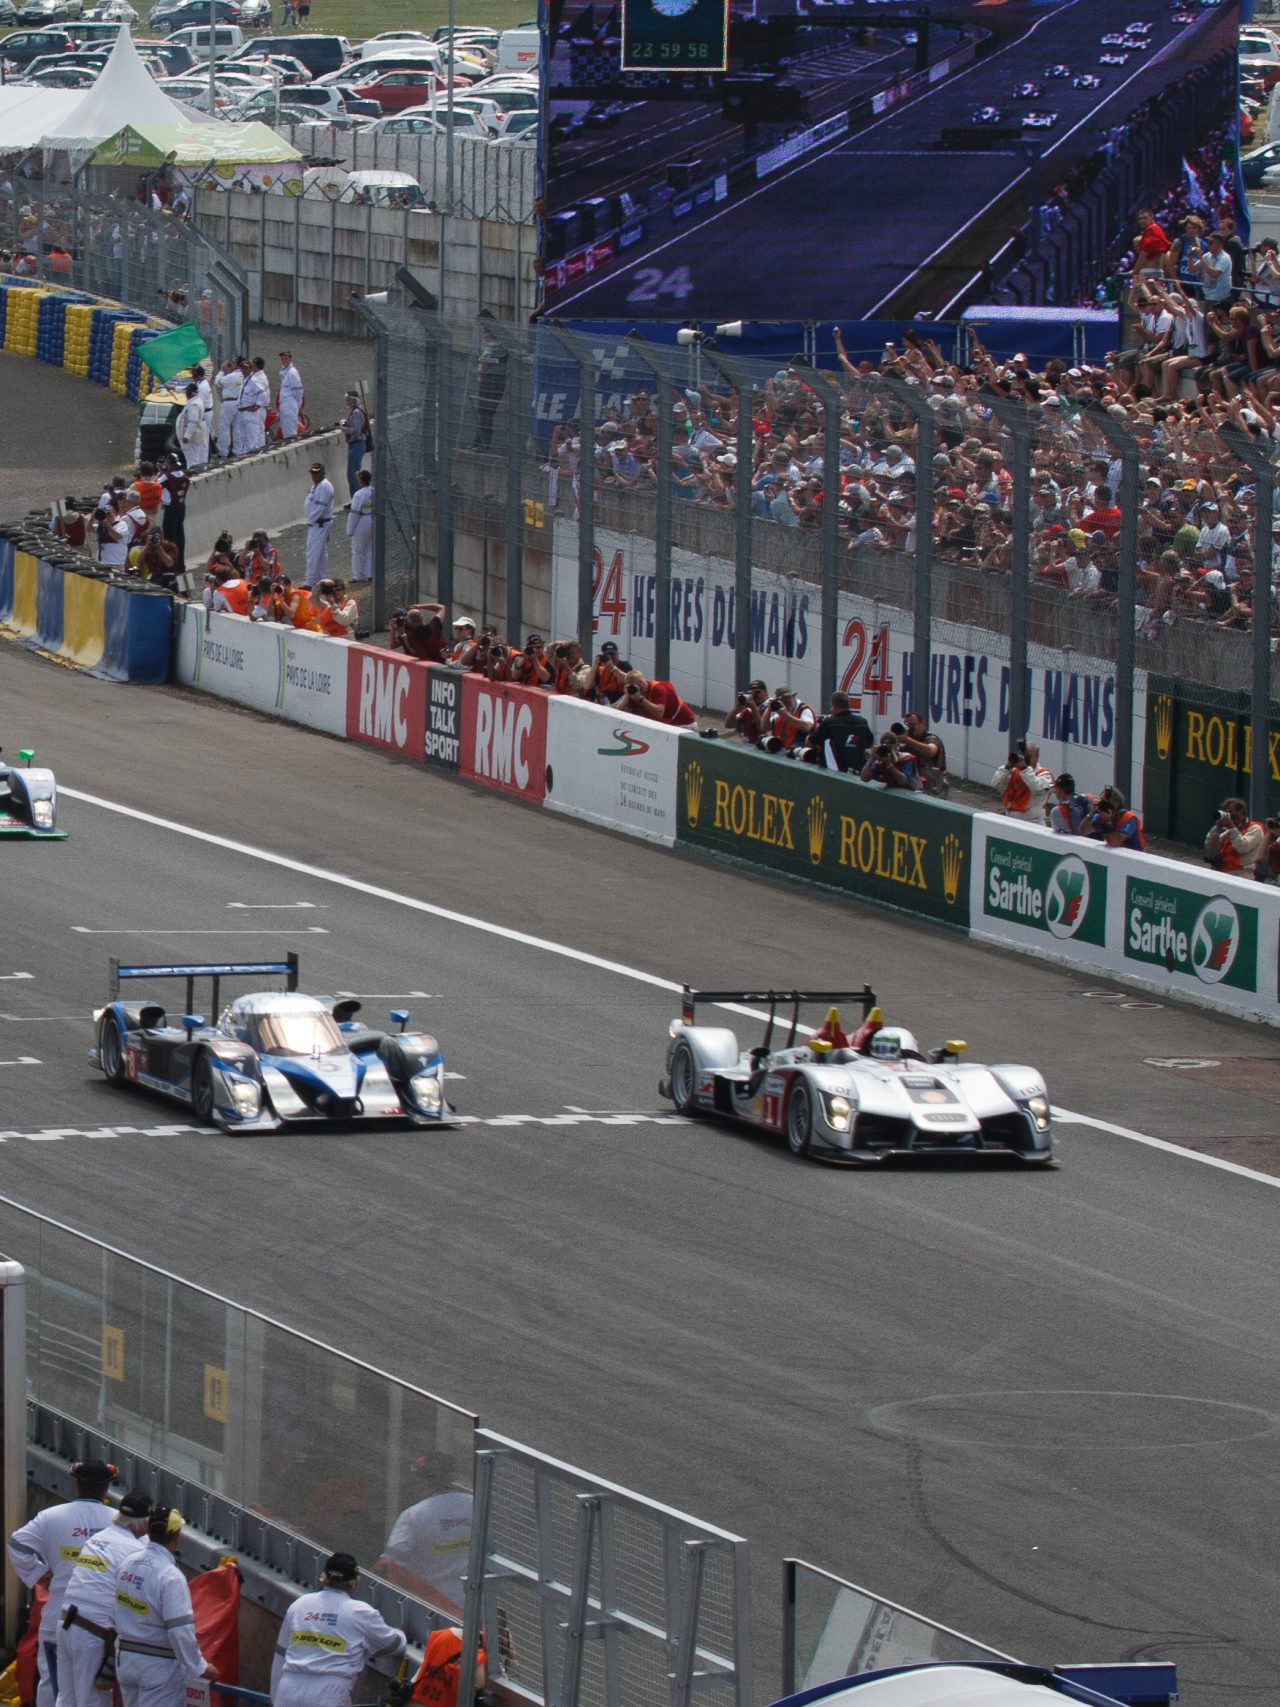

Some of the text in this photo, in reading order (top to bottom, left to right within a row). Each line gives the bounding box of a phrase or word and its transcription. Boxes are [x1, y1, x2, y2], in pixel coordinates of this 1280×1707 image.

[627, 266, 694, 301] 24
[537, 393, 566, 420] LE
[632, 575, 705, 643] HERES
[751, 589, 809, 660] MANS
[204, 640, 215, 662] PAYS
[230, 648, 244, 671] LOIRE
[287, 664, 299, 687] PAYS
[316, 672, 331, 695] LOIRE
[431, 679, 456, 707] INFO
[842, 616, 893, 716] 24
[902, 651, 988, 729] HURES
[1043, 670, 1114, 748] MANS
[359, 655, 411, 748] RMC
[430, 706, 456, 735] TALK
[425, 731, 459, 763] SPORT
[474, 692, 532, 790] RMC
[713, 780, 795, 850] ROLEX
[839, 815, 928, 890] ROLEX
[990, 846, 1032, 873] Conseil général
[989, 866, 1042, 919] Sarthe
[1131, 887, 1177, 915] Conseil général
[1130, 907, 1188, 962] Sarthe
[72, 1528, 88, 1537] 24
[121, 1572, 133, 1582] 24
[304, 1612, 319, 1621] 24
[299, 1635, 341, 1648] DUNLOP
